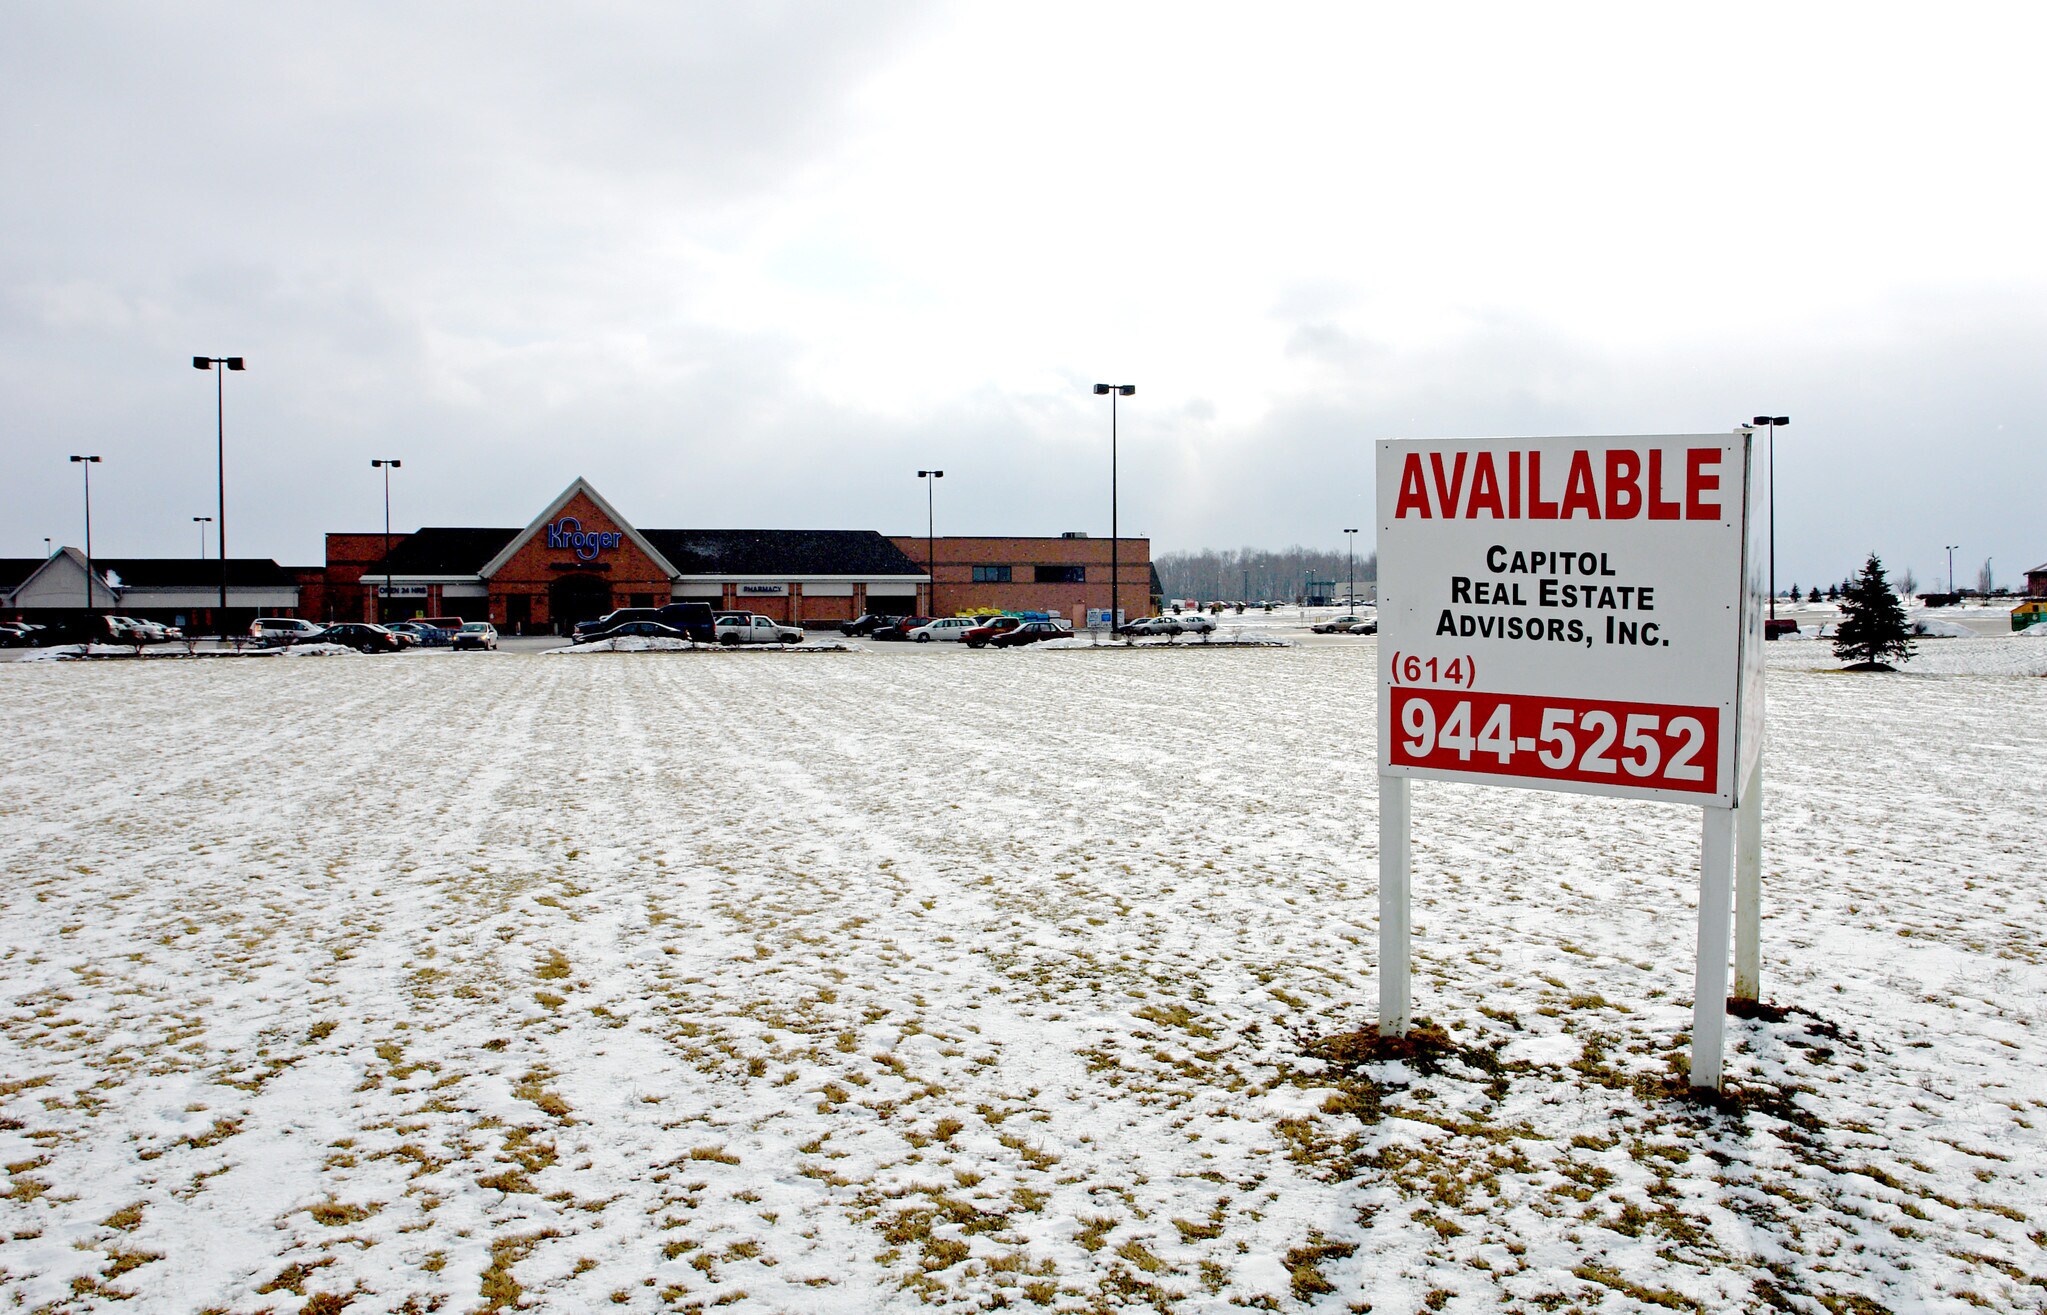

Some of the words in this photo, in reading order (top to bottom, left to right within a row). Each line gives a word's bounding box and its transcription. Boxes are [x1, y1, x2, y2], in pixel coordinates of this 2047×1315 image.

[1395, 448, 1722, 521] AVAILABLE
[548, 517, 622, 560] Kroger
[1486, 545, 1616, 576] CAPITOL
[1451, 576, 1527, 606] REAL
[1539, 579, 1654, 610] ESTATE
[1435, 609, 1592, 648] ADVISORS,
[1606, 615, 1669, 647] INC.
[1391, 651, 1476, 689] (614)
[1401, 697, 1705, 782] 944-5252
